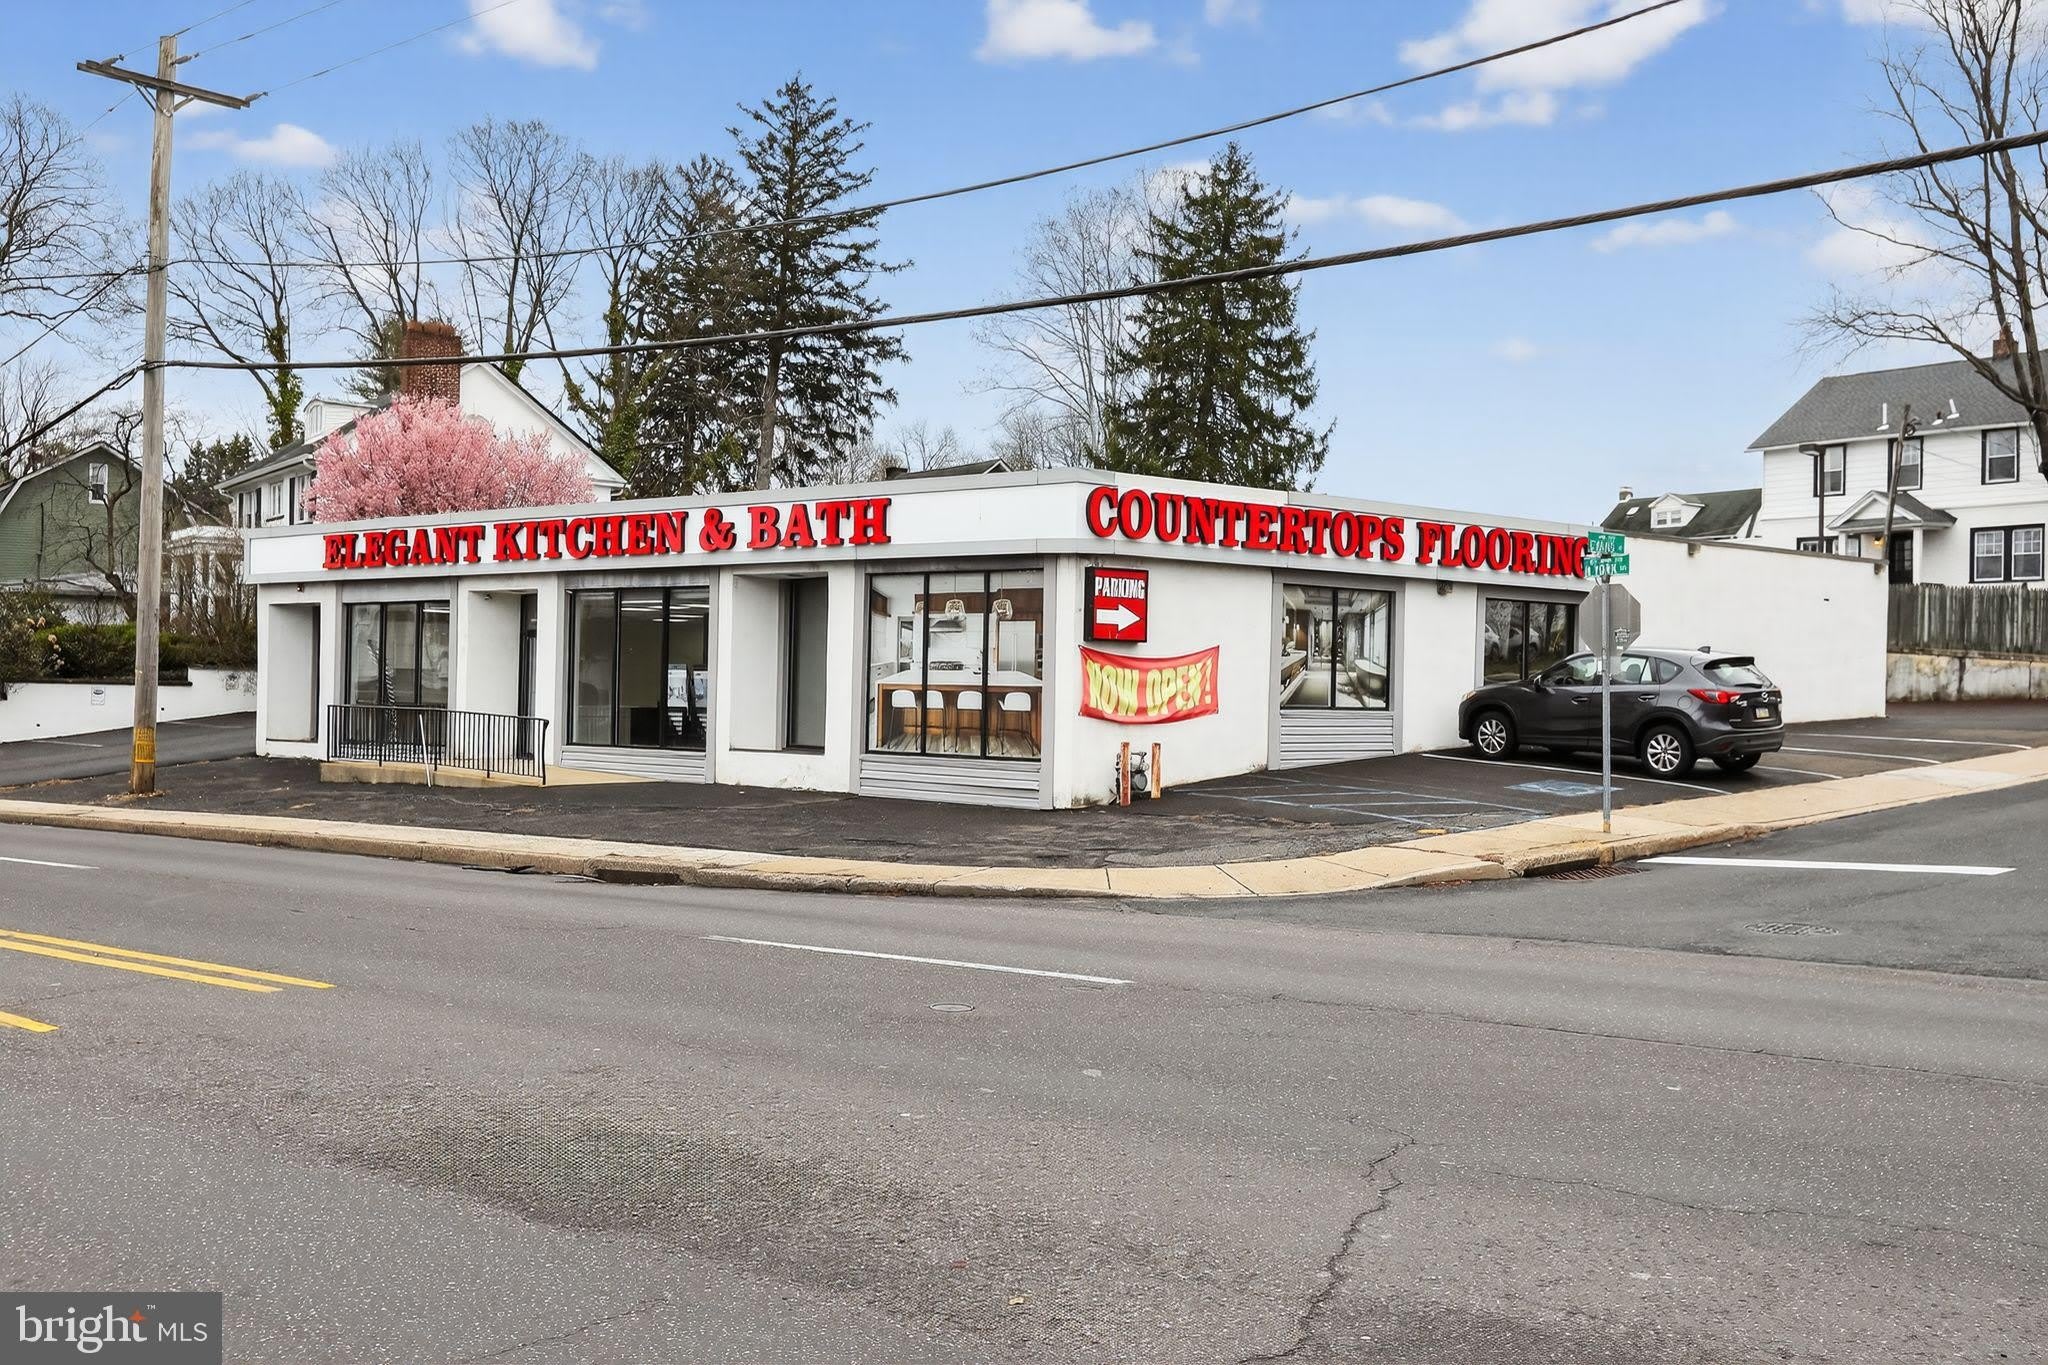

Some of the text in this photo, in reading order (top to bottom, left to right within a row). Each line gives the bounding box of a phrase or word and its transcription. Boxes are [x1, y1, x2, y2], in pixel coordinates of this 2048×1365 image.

[322, 497, 892, 570] ELEGANT KITCHEN & BATH
[1086, 486, 1404, 562] COUNTERTOPS
[1094, 576, 1146, 600] PARKING
[1086, 657, 1213, 717] NOW OPEN!
